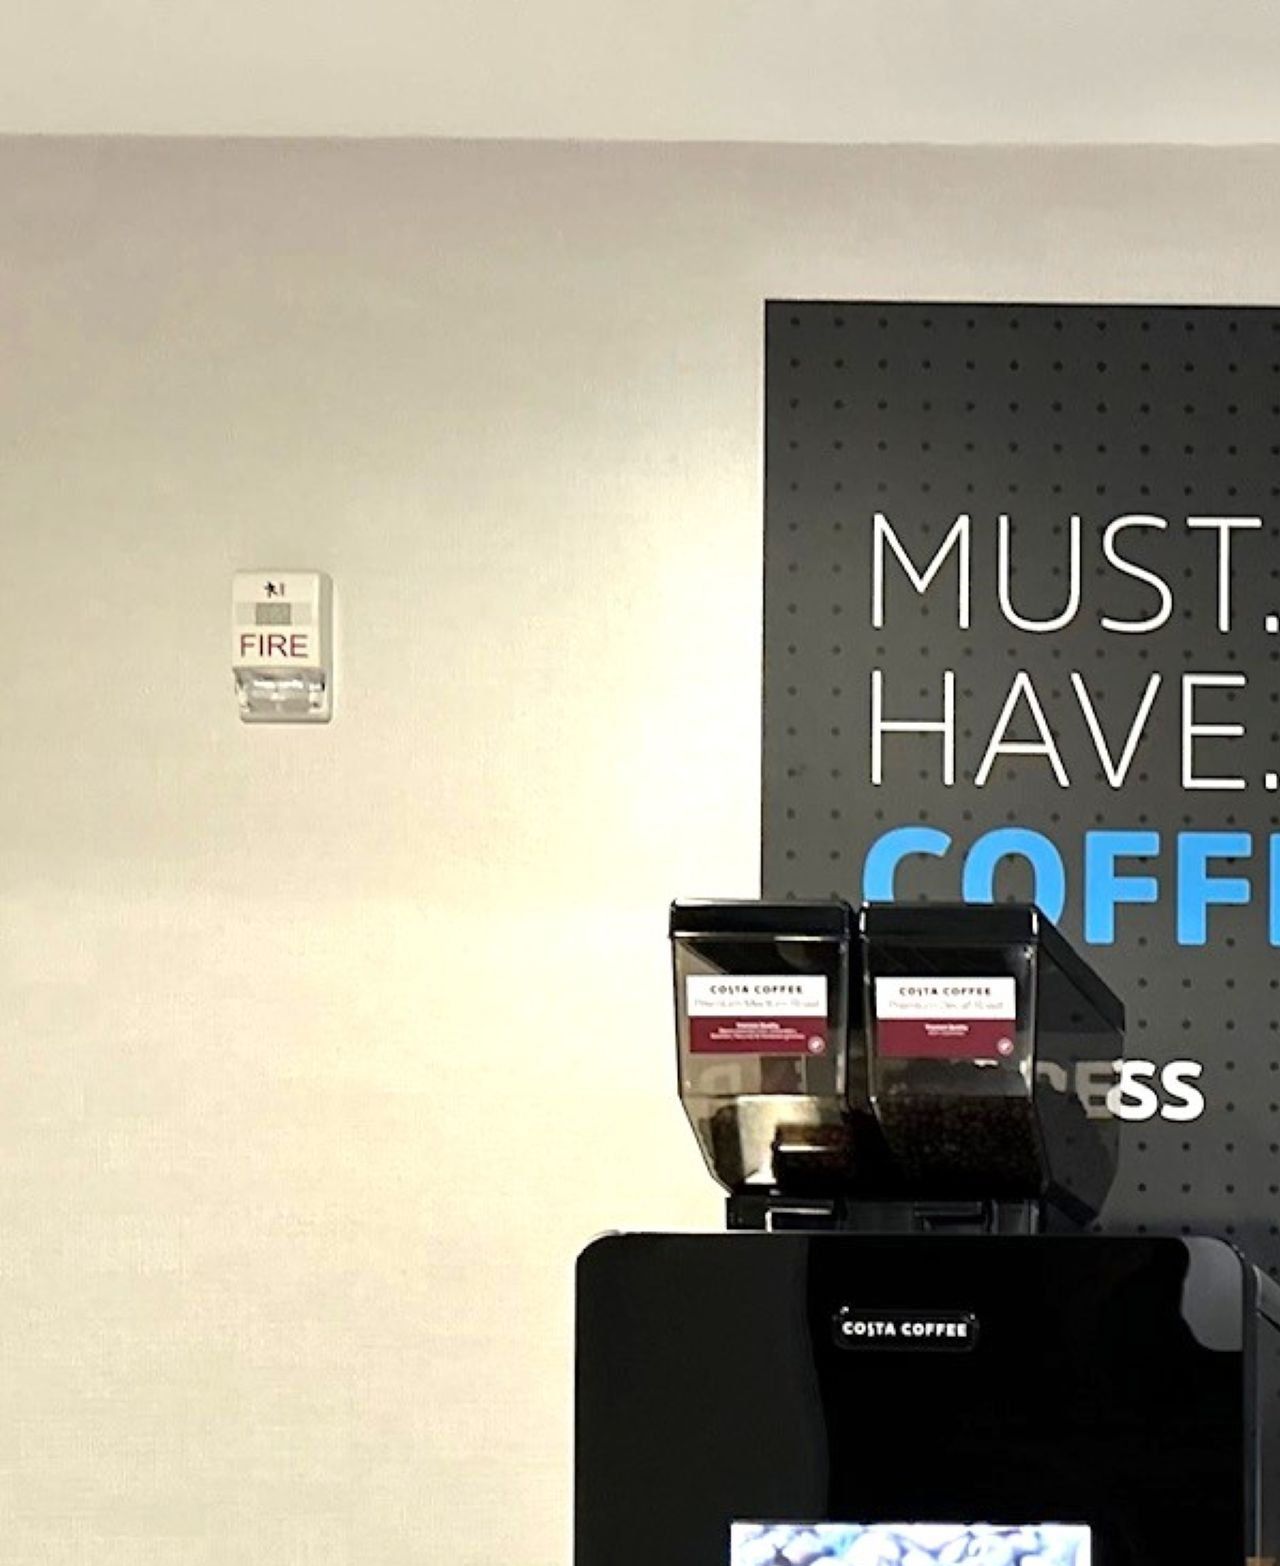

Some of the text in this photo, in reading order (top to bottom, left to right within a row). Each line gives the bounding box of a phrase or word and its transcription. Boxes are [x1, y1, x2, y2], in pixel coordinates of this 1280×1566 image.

[873, 512, 1280, 633] MUST.
[240, 633, 309, 658] FIRE
[870, 670, 1280, 790] HAVE.
[709, 984, 803, 995] COSTA COFFEE
[898, 987, 992, 997] COSTA COFFEE
[841, 1321, 968, 1337] COSTA COFFEE
